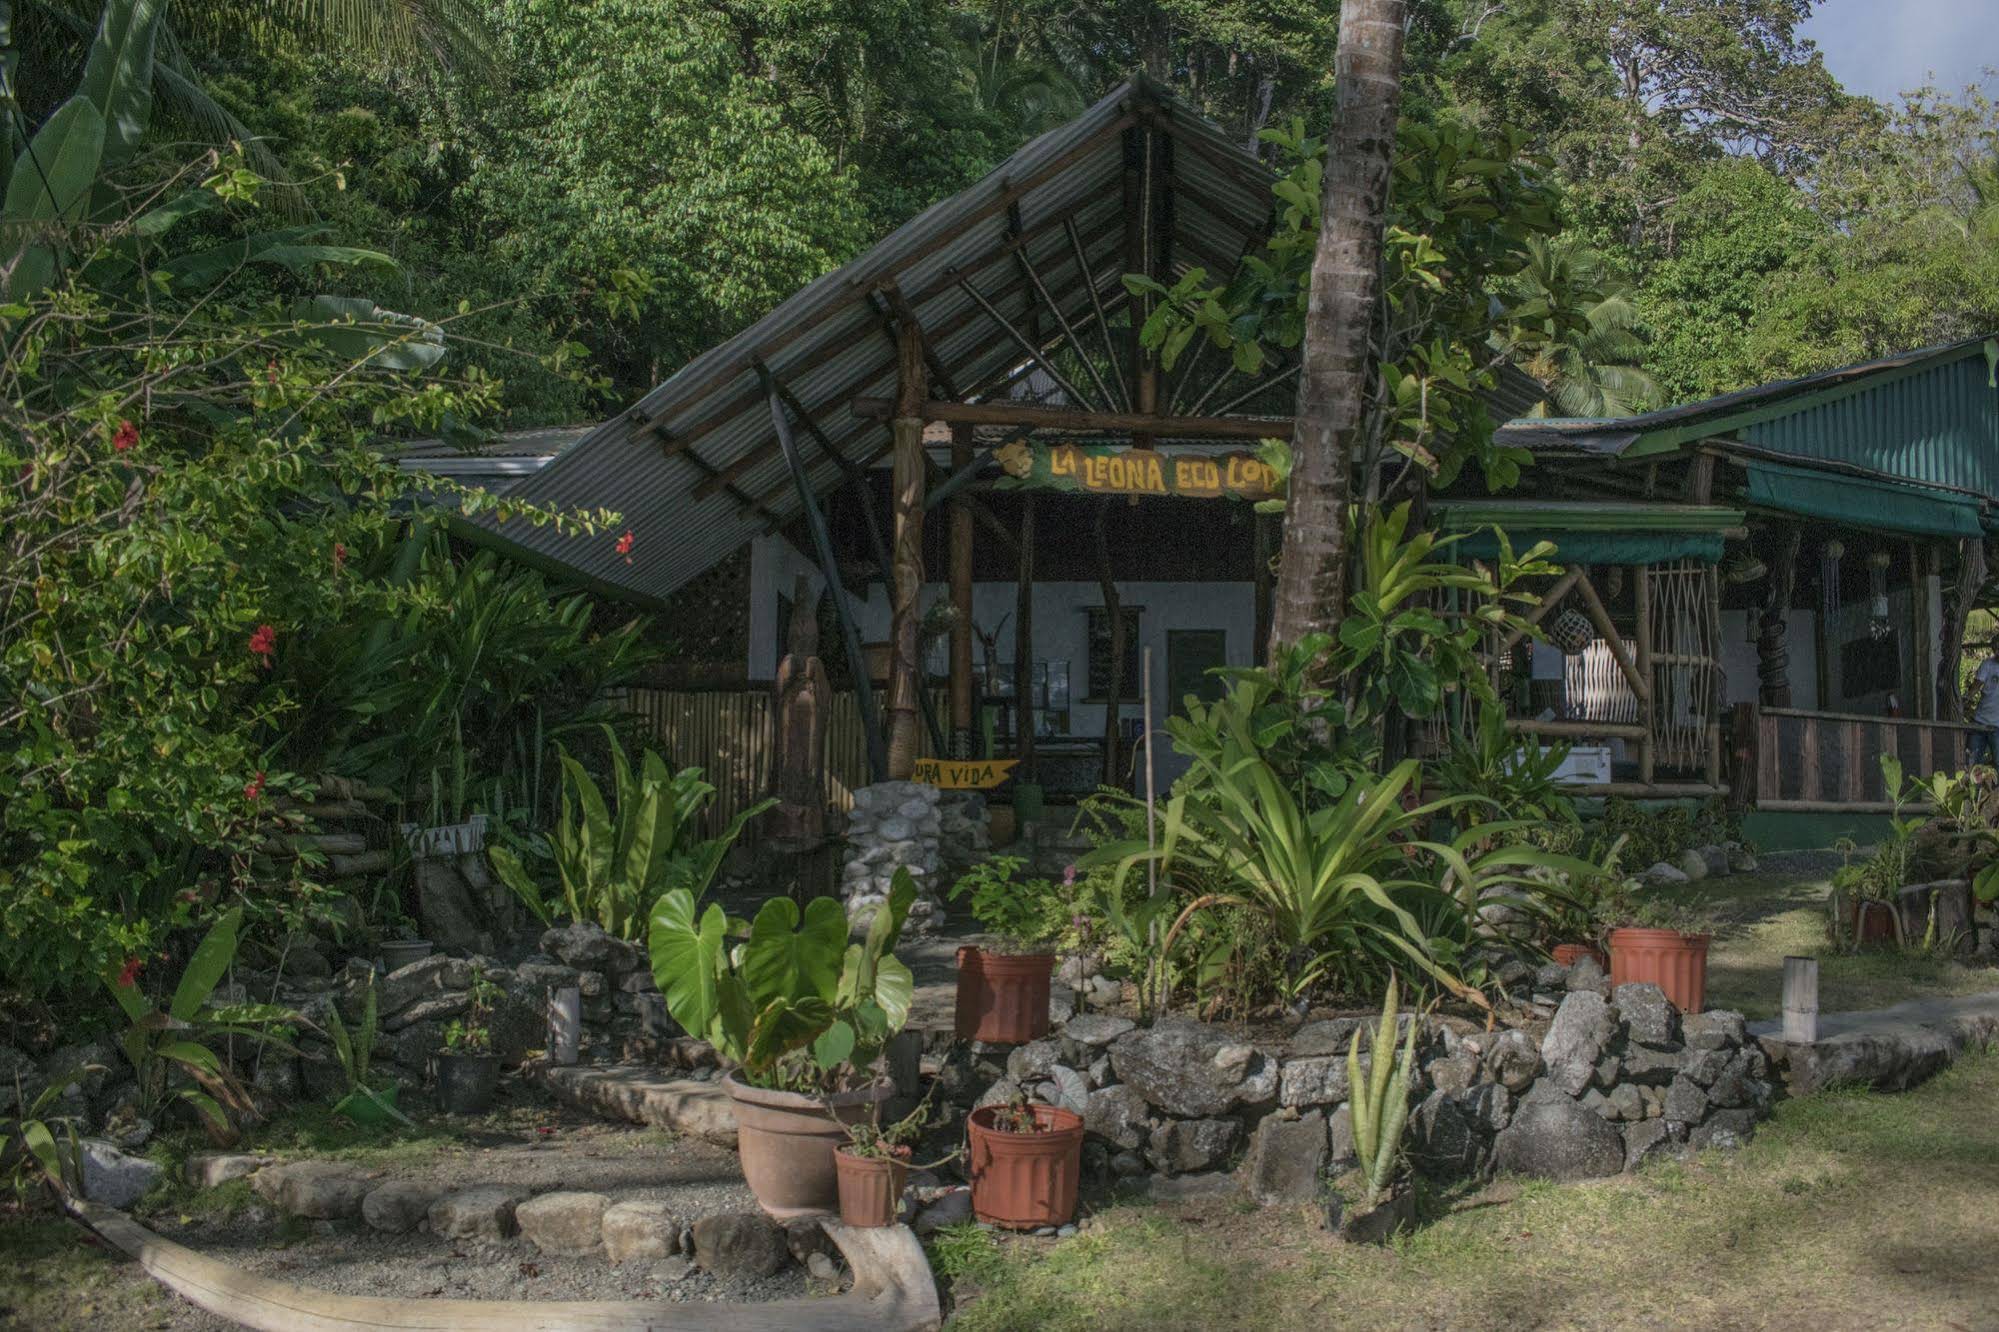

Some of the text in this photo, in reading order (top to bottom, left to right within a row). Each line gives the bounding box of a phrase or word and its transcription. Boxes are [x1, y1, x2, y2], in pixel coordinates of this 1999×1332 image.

[1051, 448, 1279, 494] LA LEONA ECO LOD
[915, 762, 942, 785] URA
